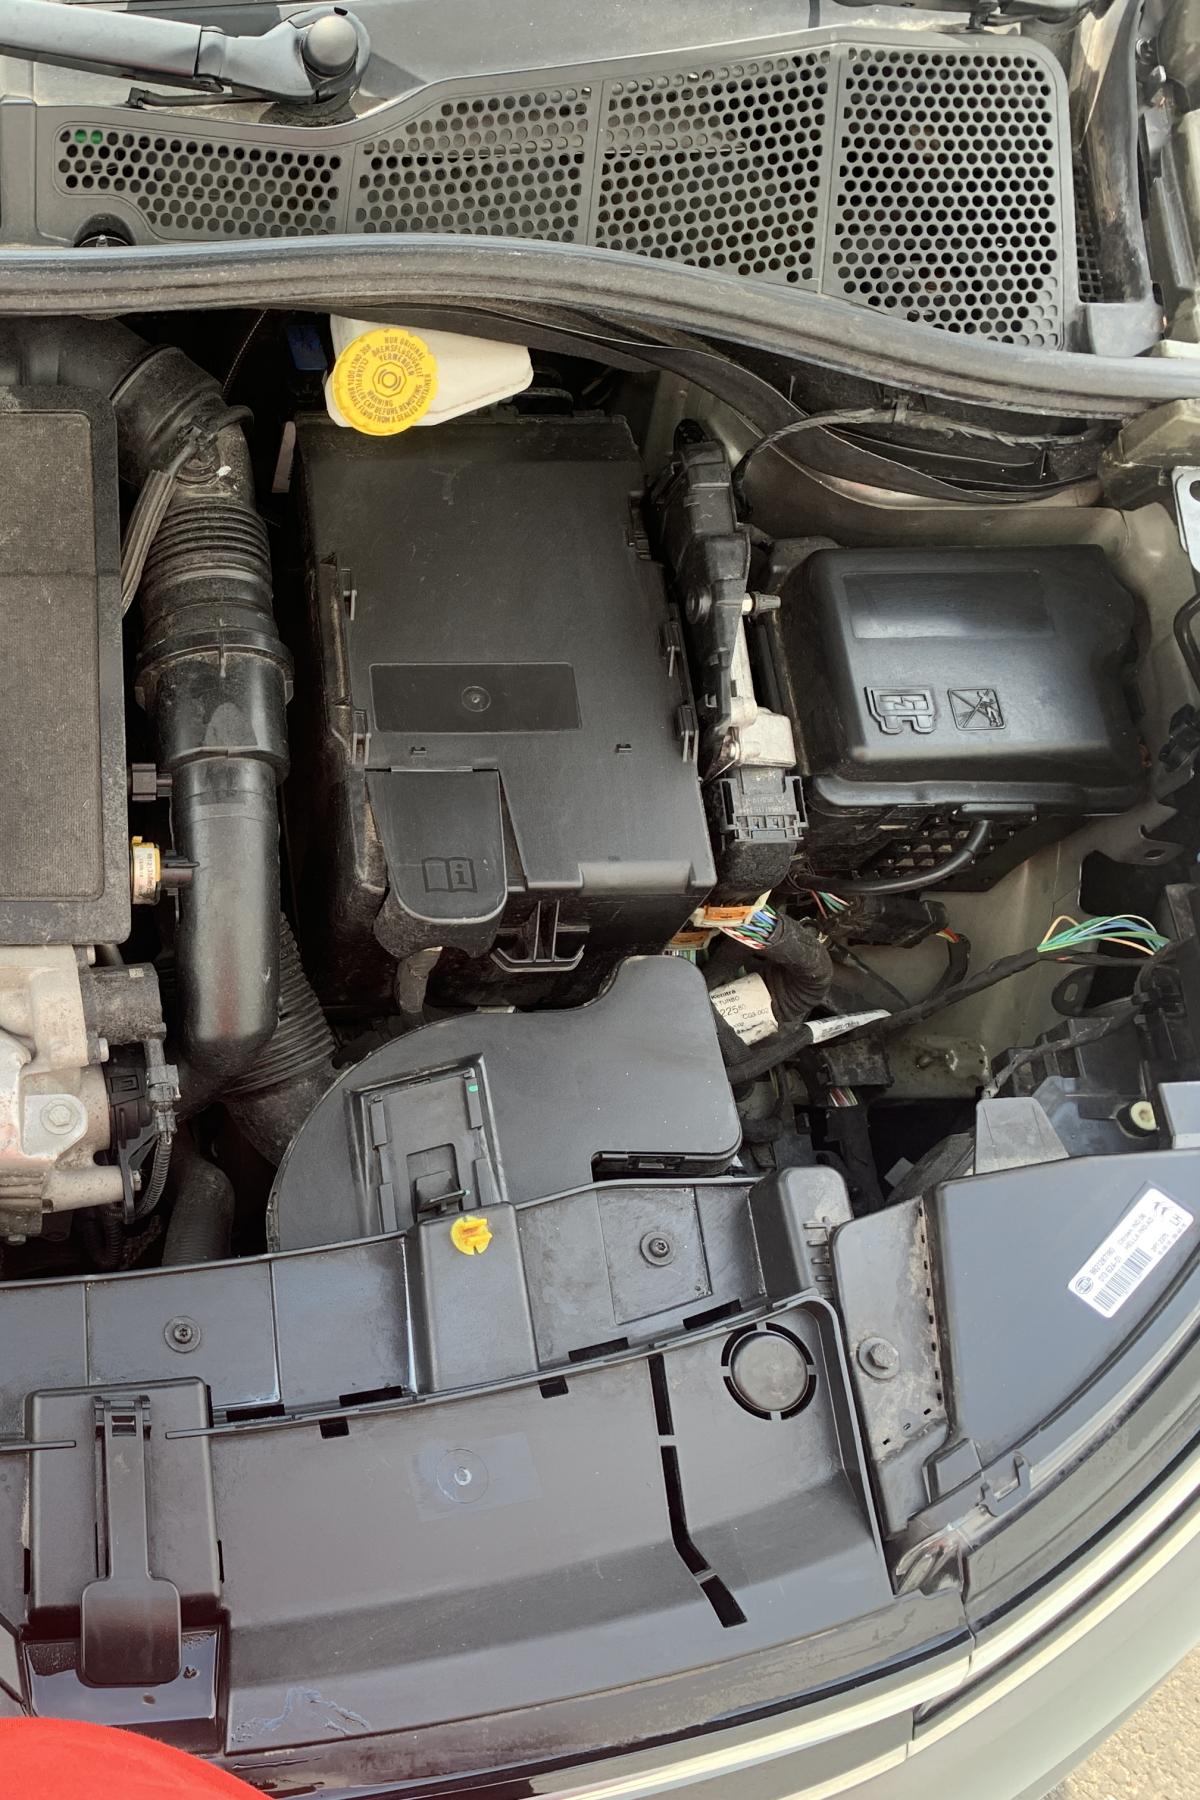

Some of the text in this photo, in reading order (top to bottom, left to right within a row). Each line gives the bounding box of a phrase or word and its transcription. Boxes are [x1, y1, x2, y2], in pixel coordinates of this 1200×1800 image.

[363, 399, 376, 409] CAP
[375, 407, 399, 415] BEFORE
[399, 384, 422, 412] REMOVING
[367, 390, 393, 407] WARNING
[373, 414, 390, 423] FROM
[397, 406, 418, 422] SEALED
[416, 374, 431, 406] CONTAINER
[1169, 1213, 1183, 1226] LH
